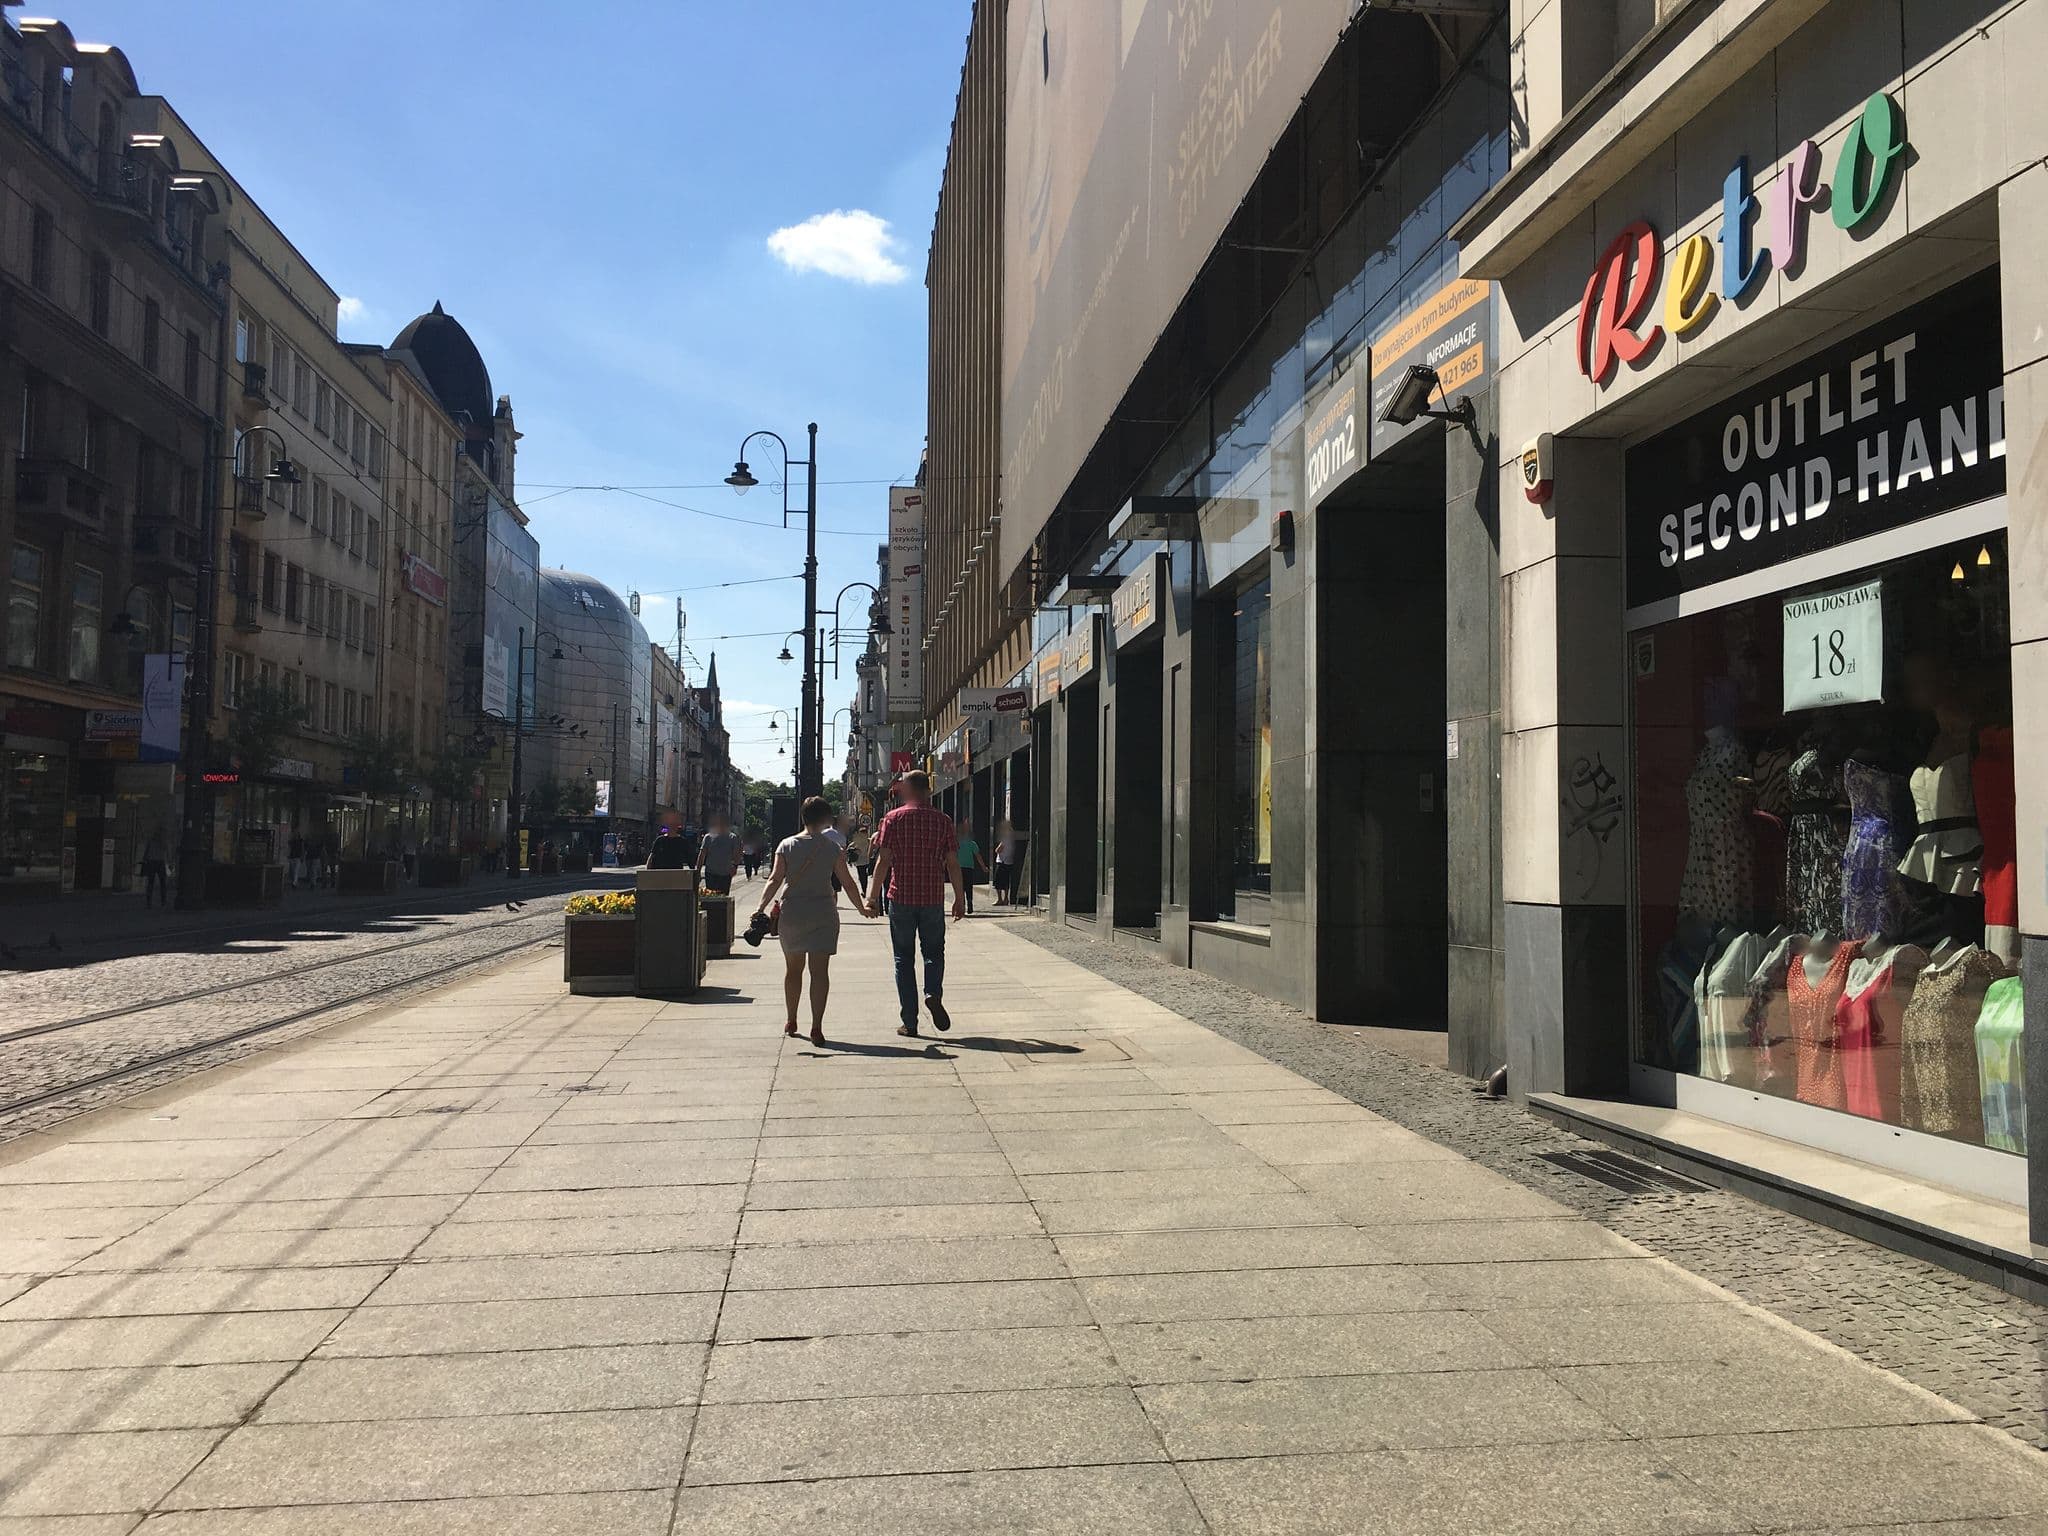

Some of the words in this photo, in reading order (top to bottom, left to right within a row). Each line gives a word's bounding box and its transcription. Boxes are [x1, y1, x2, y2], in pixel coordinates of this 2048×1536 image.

[1179, 38, 1233, 181] SILESIA
[1179, 143, 1209, 240] CITY
[1213, 5, 1282, 177] CENTER
[1576, 92, 1904, 383] Retro
[1422, 311, 1438, 333] tym
[1426, 322, 1477, 366] INFORMACJE
[1442, 364, 1458, 386] 421
[1461, 353, 1478, 377] 965
[1722, 333, 1917, 472] OUTLET
[1307, 439, 1330, 500] 1200
[1331, 414, 1355, 475] m2
[894, 544, 920, 552] obcych
[1785, 601, 1819, 620] NOWA
[1821, 587, 1879, 612] DOSTAWA
[1811, 629, 1845, 680] 18
[962, 701, 991, 713] empik
[998, 694, 1024, 707] school
[1820, 691, 1845, 703] SZTUKA
